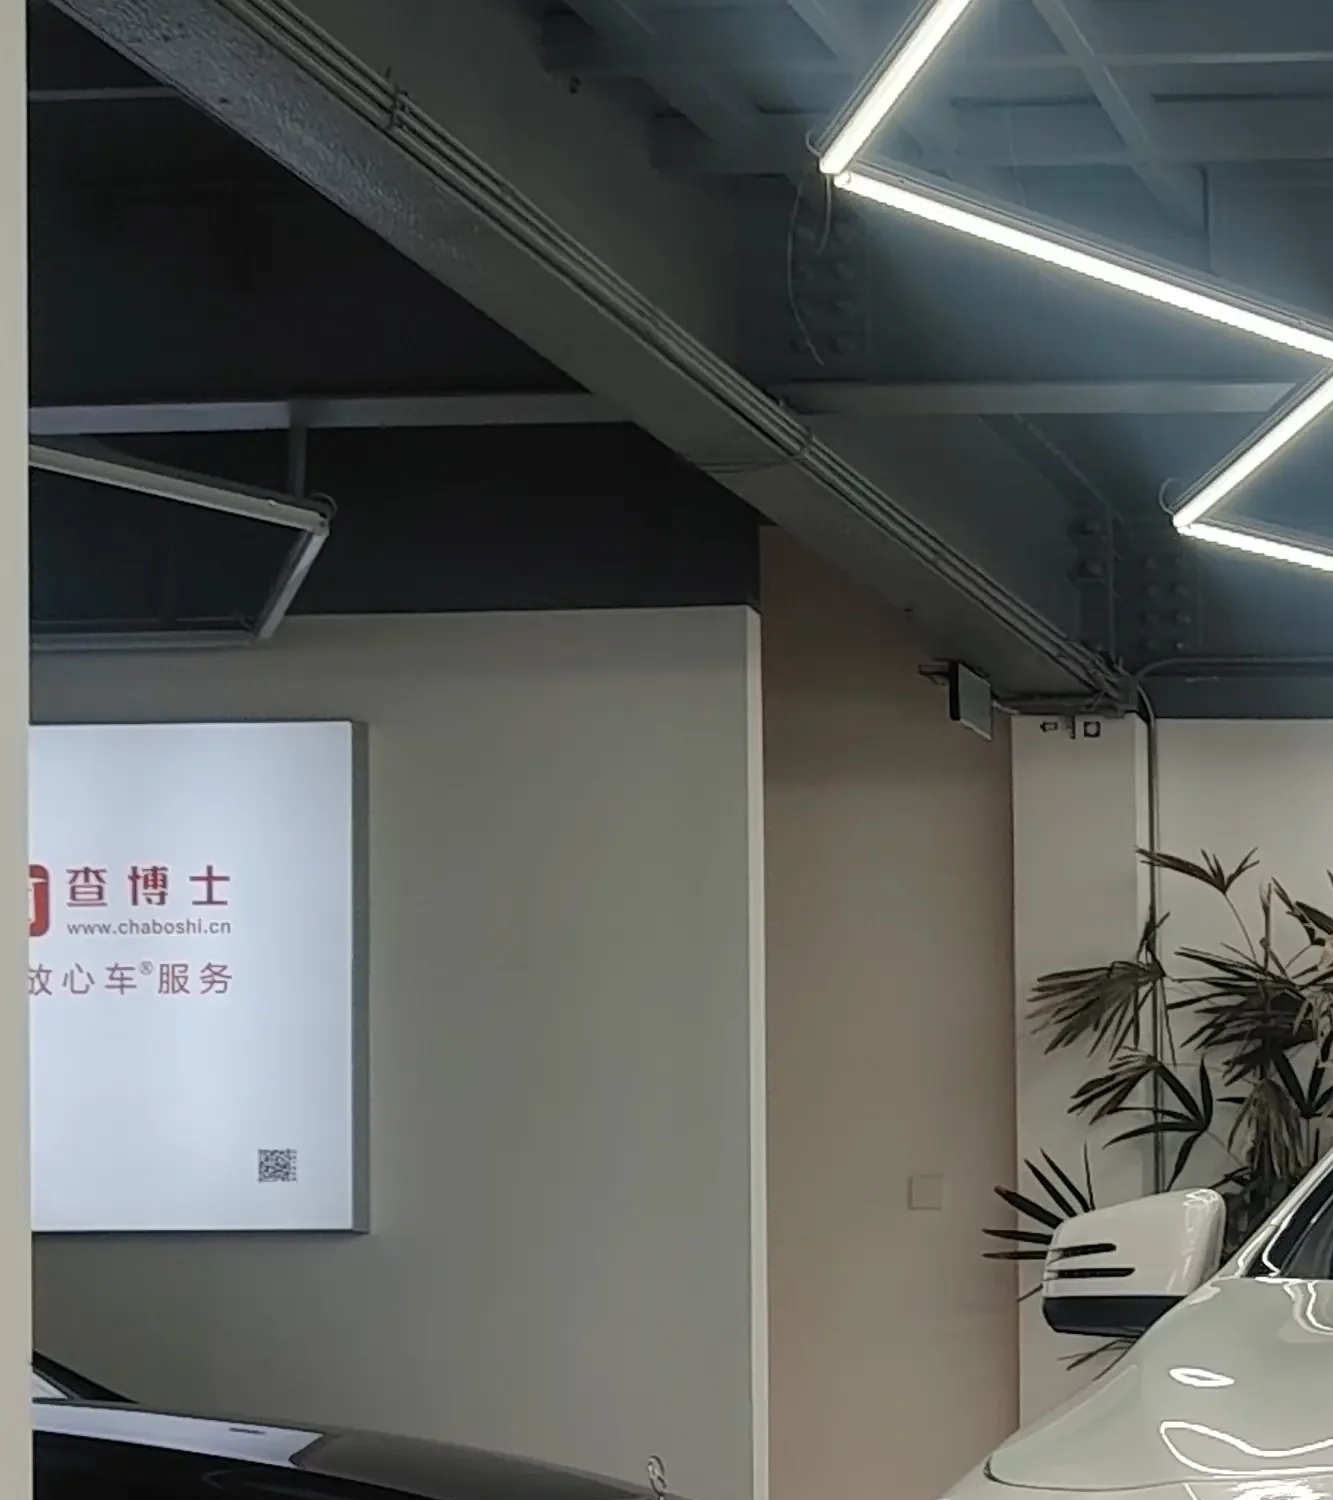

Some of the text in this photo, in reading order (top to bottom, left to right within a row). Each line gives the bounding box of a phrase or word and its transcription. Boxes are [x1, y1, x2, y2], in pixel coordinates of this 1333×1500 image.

[66, 864, 231, 907] 查博士
[66, 918, 232, 935] www.chaboshi.cn
